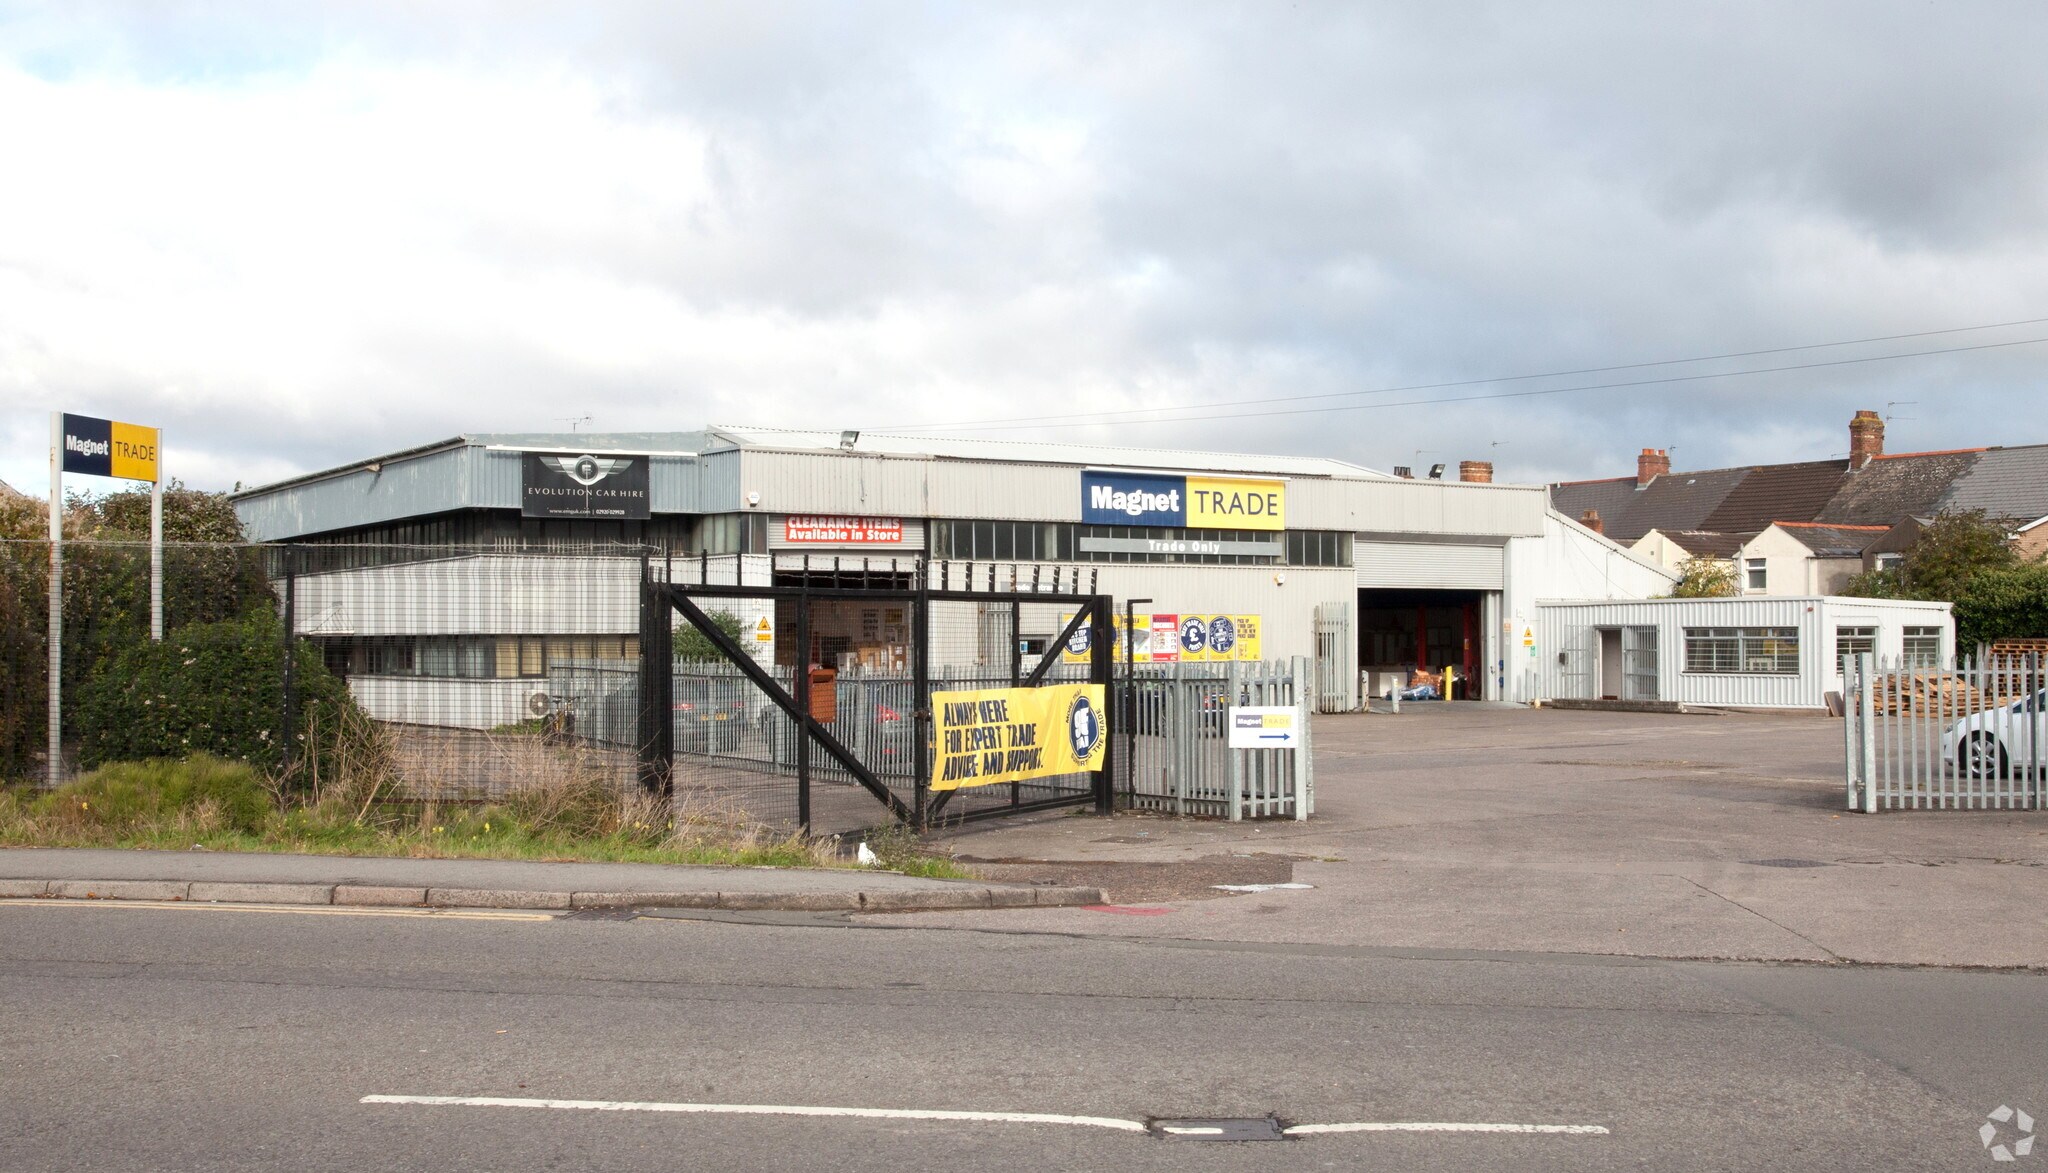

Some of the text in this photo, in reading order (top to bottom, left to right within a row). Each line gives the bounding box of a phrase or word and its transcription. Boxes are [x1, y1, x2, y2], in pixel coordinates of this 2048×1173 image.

[66, 434, 155, 461] Magnet TRADE
[528, 487, 644, 498] EVOLUTION CAR HIRE
[1090, 485, 1278, 516] Magnet TRADE
[787, 516, 900, 529] CLEARANCE ITEMS
[788, 528, 848, 540] Available
[867, 529, 900, 541] Store
[1148, 540, 1220, 555] Trade Only
[943, 699, 1010, 727] ALWAYS HERE
[1237, 718, 1262, 726] Magnet
[944, 723, 1037, 754] FOR EXPERT TRADE
[1092, 708, 1105, 753] THE TRADE
[941, 754, 979, 781] ADVICE
[982, 752, 1004, 776] AND
